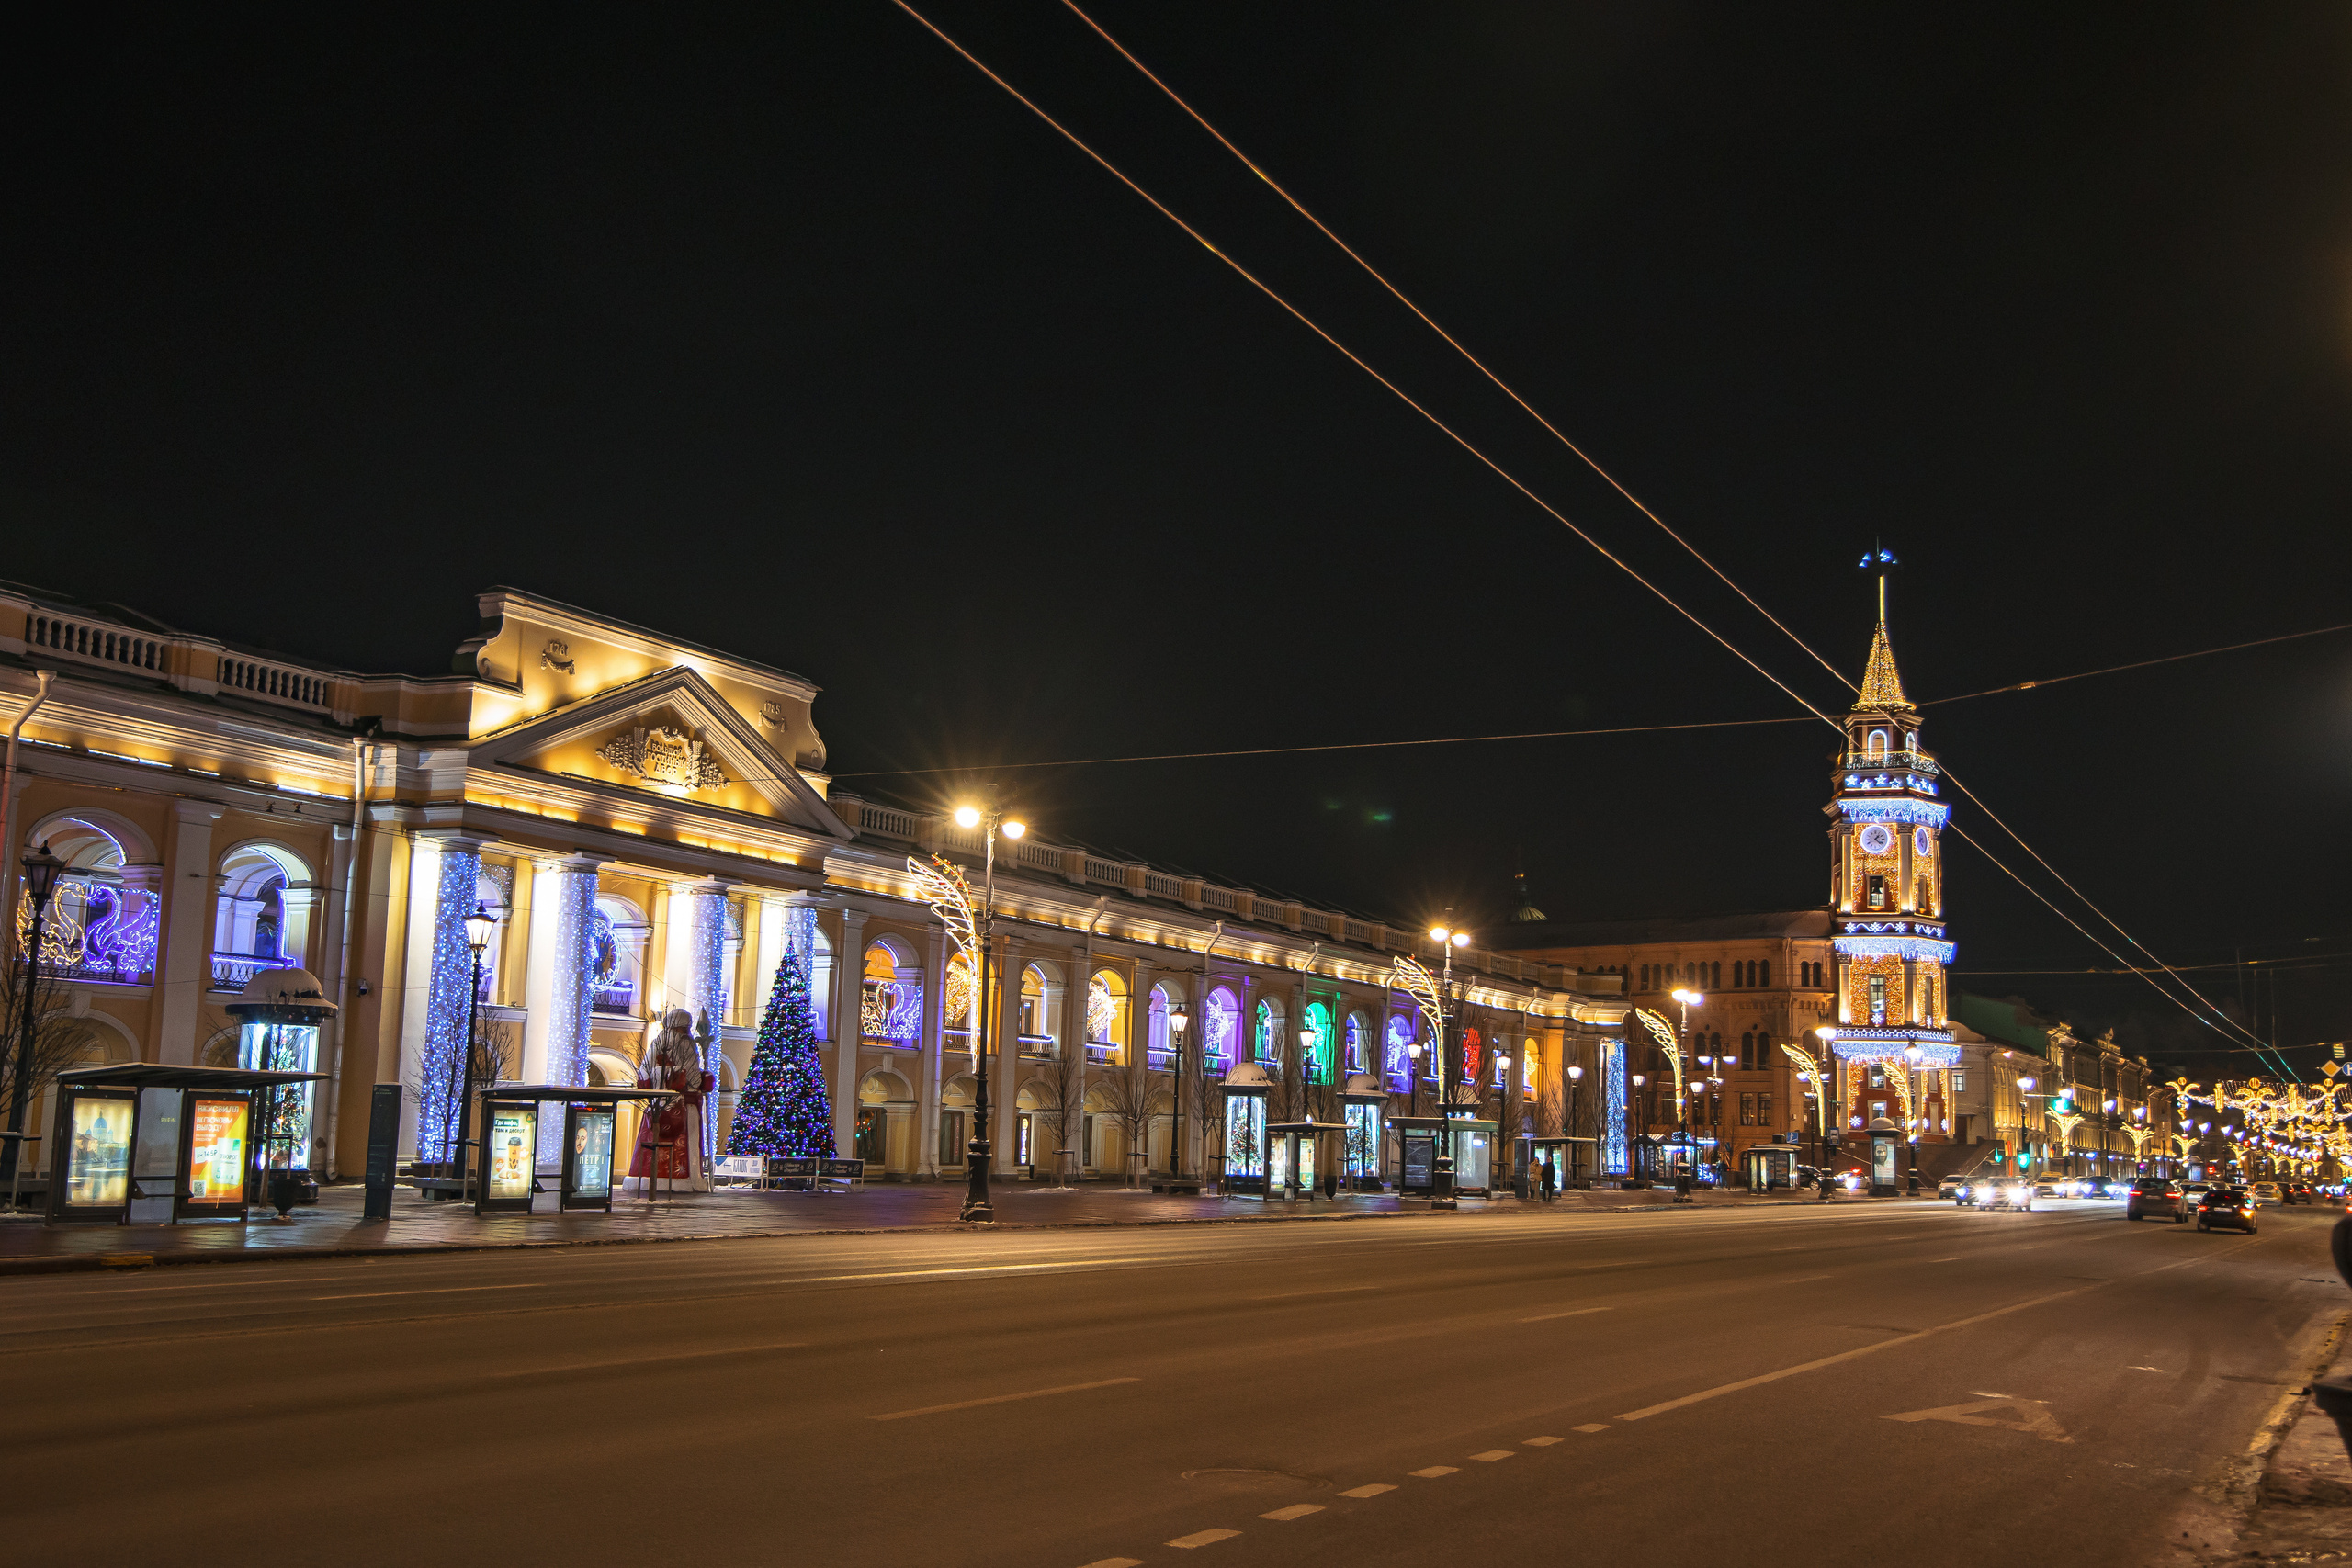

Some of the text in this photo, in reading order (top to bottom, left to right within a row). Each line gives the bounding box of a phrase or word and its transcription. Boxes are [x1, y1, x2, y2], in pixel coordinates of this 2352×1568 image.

[549, 642, 569, 657] 1761
[763, 703, 781, 715] 1785
[651, 743, 683, 756] БОЛЬШОЙ
[647, 751, 687, 768] ГОСТИНЫЙ
[654, 762, 678, 776] ДВОР
[579, 1156, 600, 1165] ПЕТР
[733, 1159, 748, 1173] КАТОК
